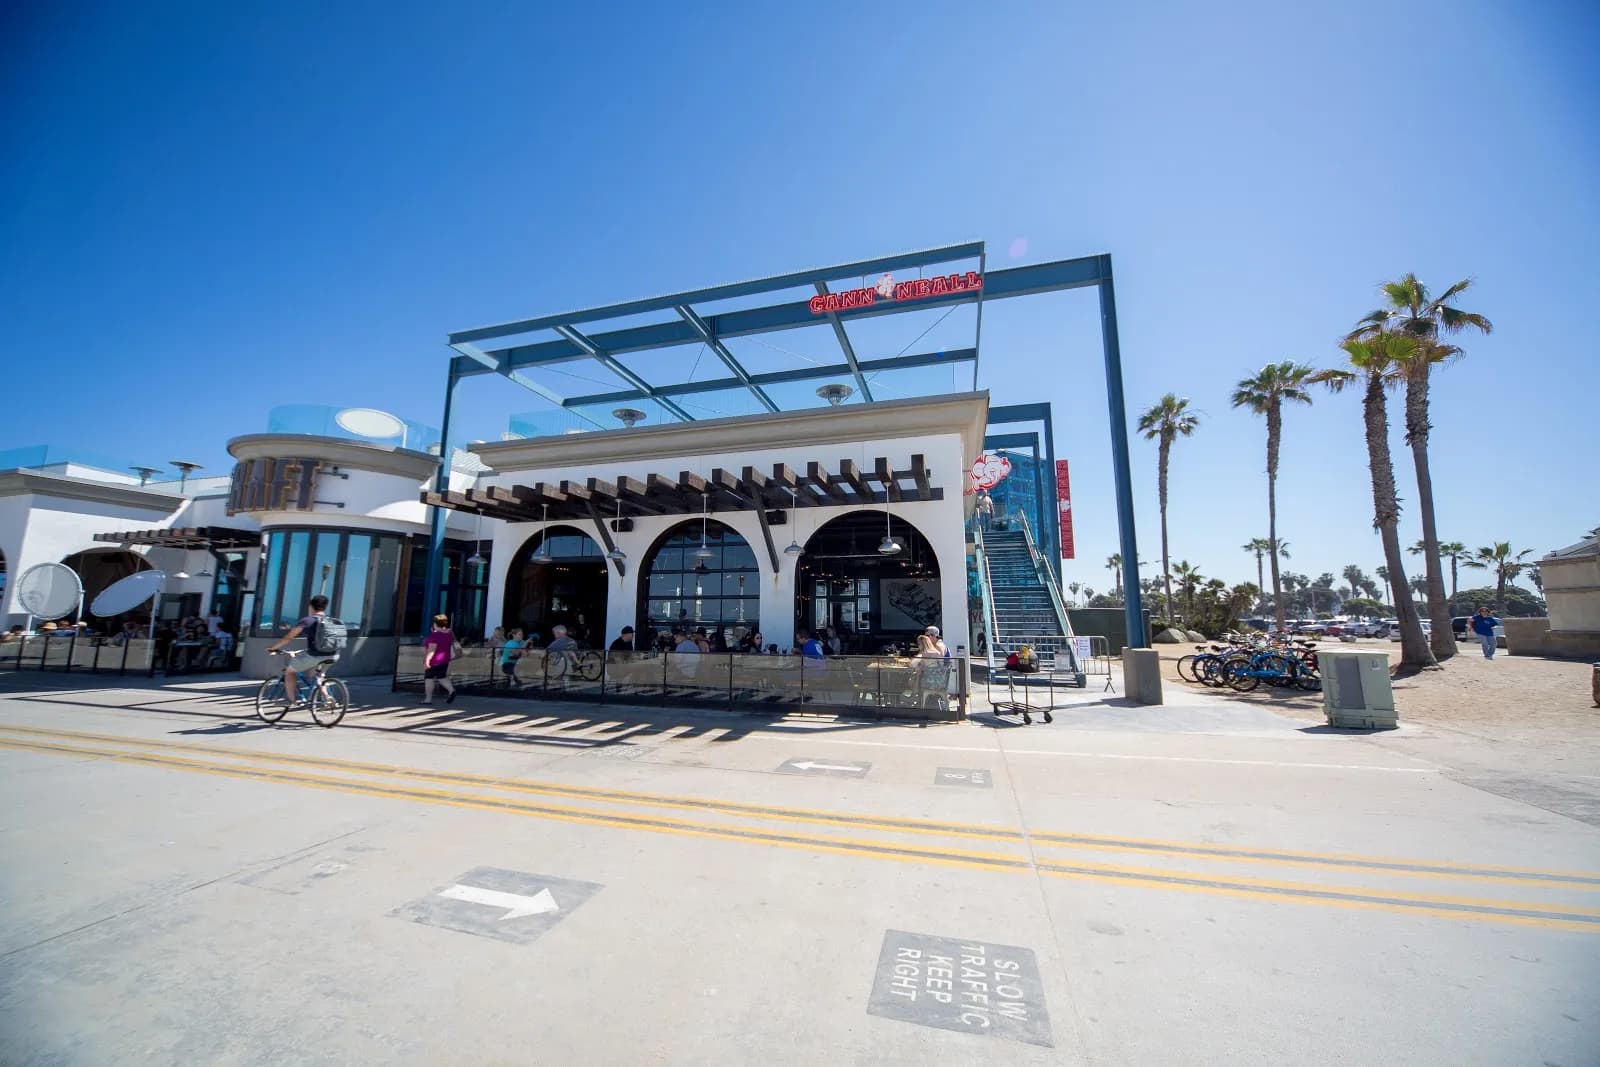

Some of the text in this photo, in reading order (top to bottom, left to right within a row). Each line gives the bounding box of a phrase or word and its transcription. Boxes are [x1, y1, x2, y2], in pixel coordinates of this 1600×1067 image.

[226, 457, 322, 516] RAFT
[890, 947, 921, 1001] RIGHT
[926, 954, 952, 1003] KEEP
[961, 945, 990, 1027] TRAFFIC
[994, 960, 1028, 1021] SLOW
